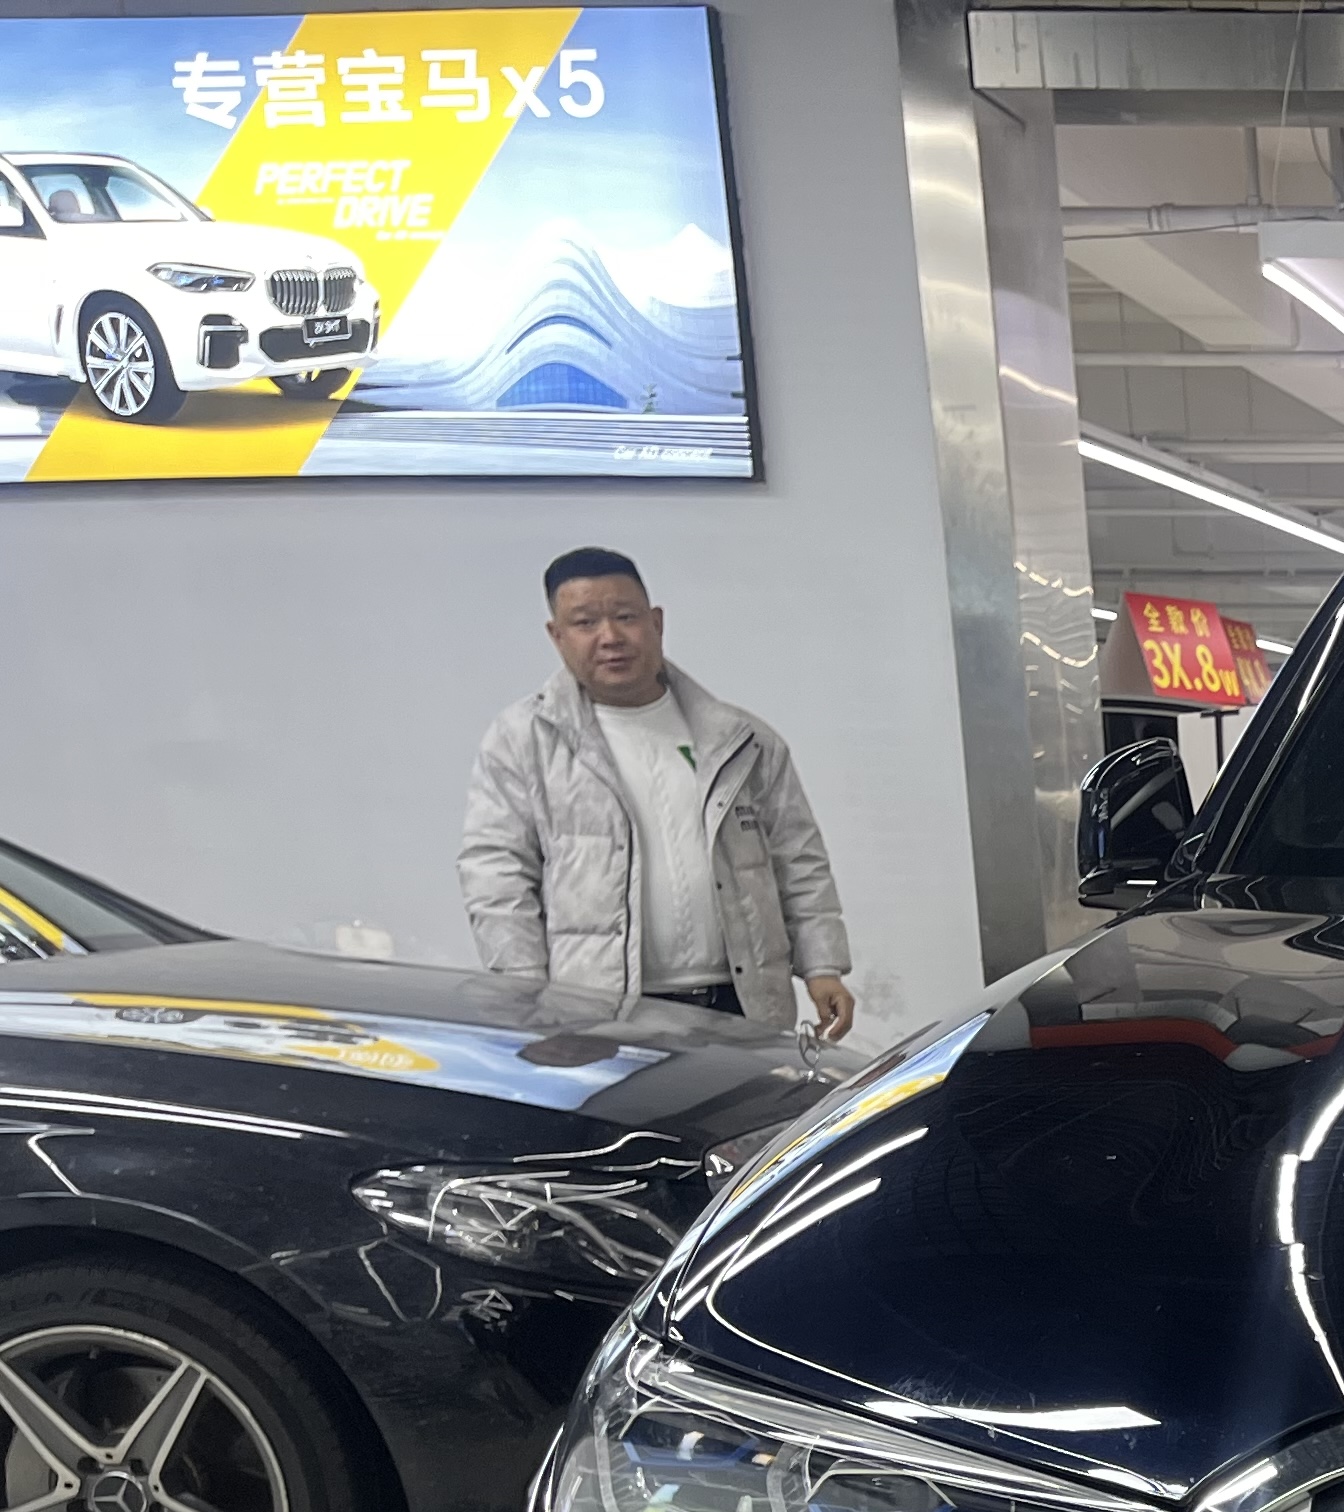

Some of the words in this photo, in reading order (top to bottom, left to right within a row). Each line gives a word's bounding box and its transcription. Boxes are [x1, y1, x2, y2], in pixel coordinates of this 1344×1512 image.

[172, 48, 606, 130] 专营宝马x5
[254, 159, 412, 196] PERFECT
[333, 193, 434, 229] DRIVE
